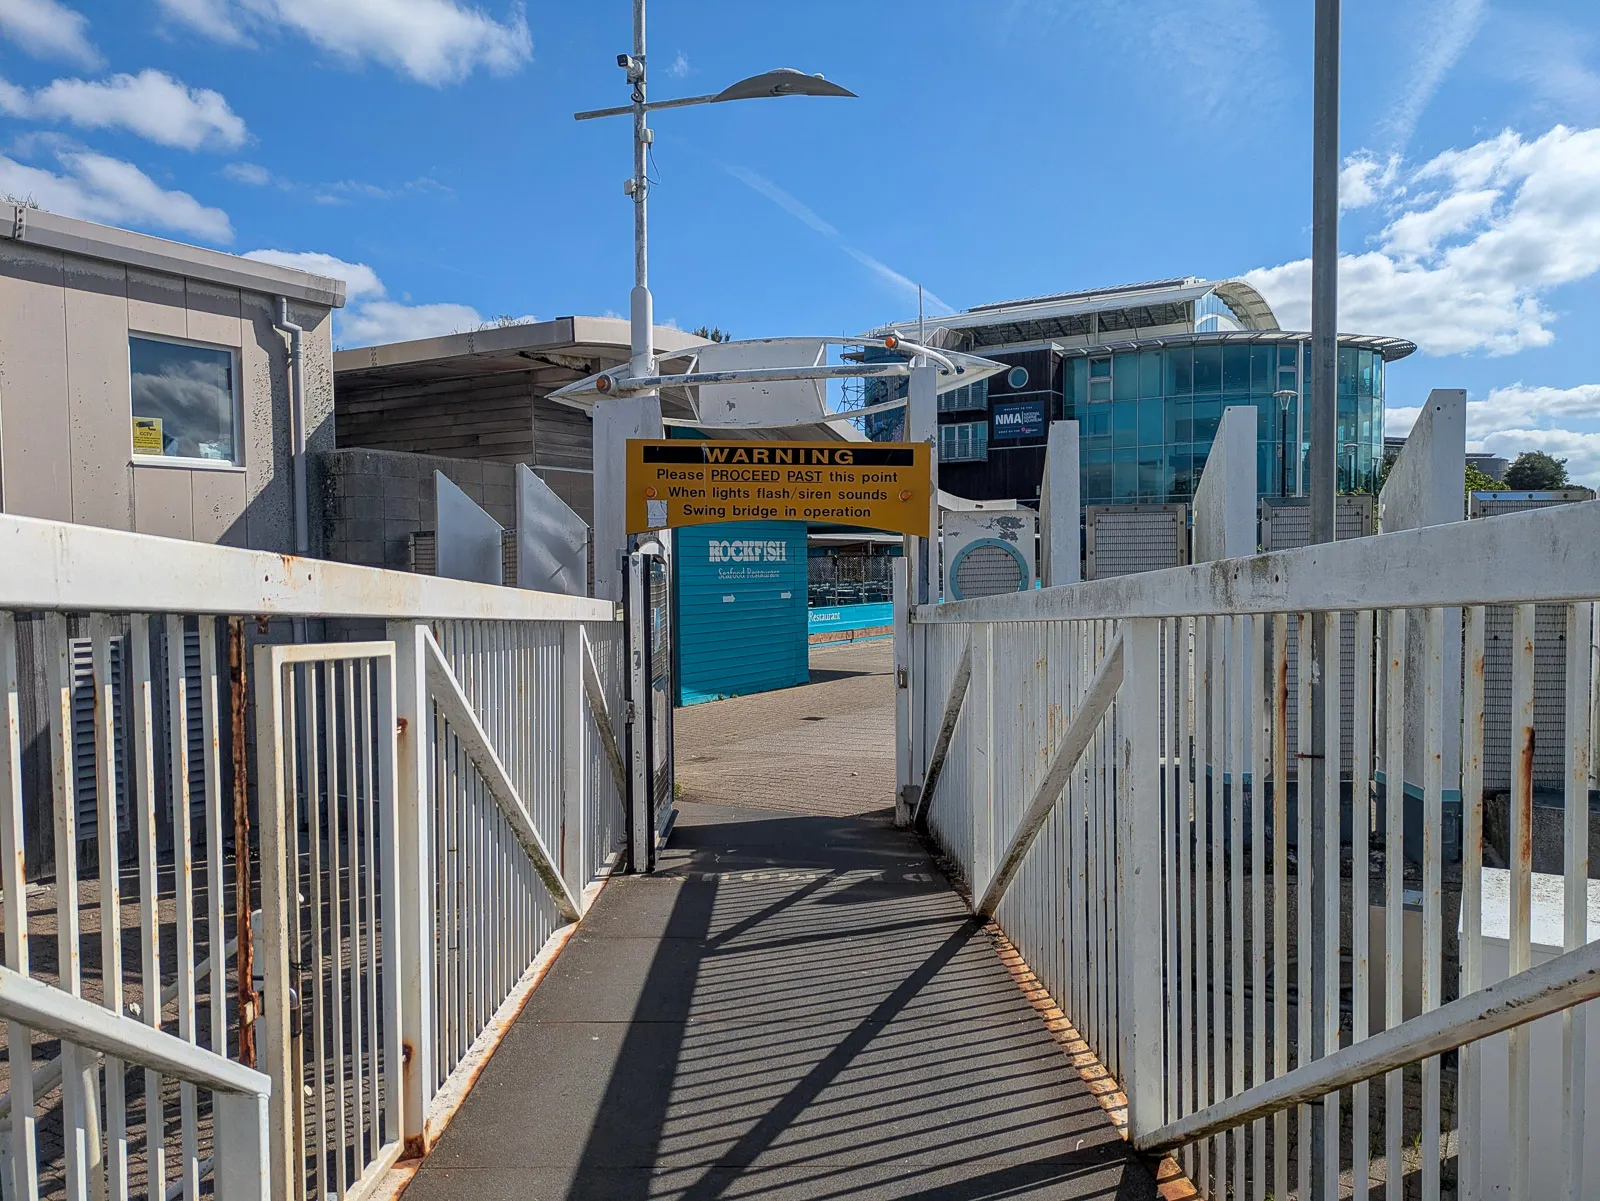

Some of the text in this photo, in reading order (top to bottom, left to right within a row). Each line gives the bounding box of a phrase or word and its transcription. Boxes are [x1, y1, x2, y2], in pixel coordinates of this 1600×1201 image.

[996, 413, 1021, 425] NMA
[706, 448, 854, 465] WARNING
[657, 468, 898, 485] Please PROCEED PAST this point
[668, 486, 888, 501] When lights flash/siren sounds
[683, 504, 871, 519] Swing bridge in operation
[709, 540, 787, 562] ROCKFISH
[718, 568, 780, 579] Seafood Restaurant
[808, 611, 841, 622] Restaurant
